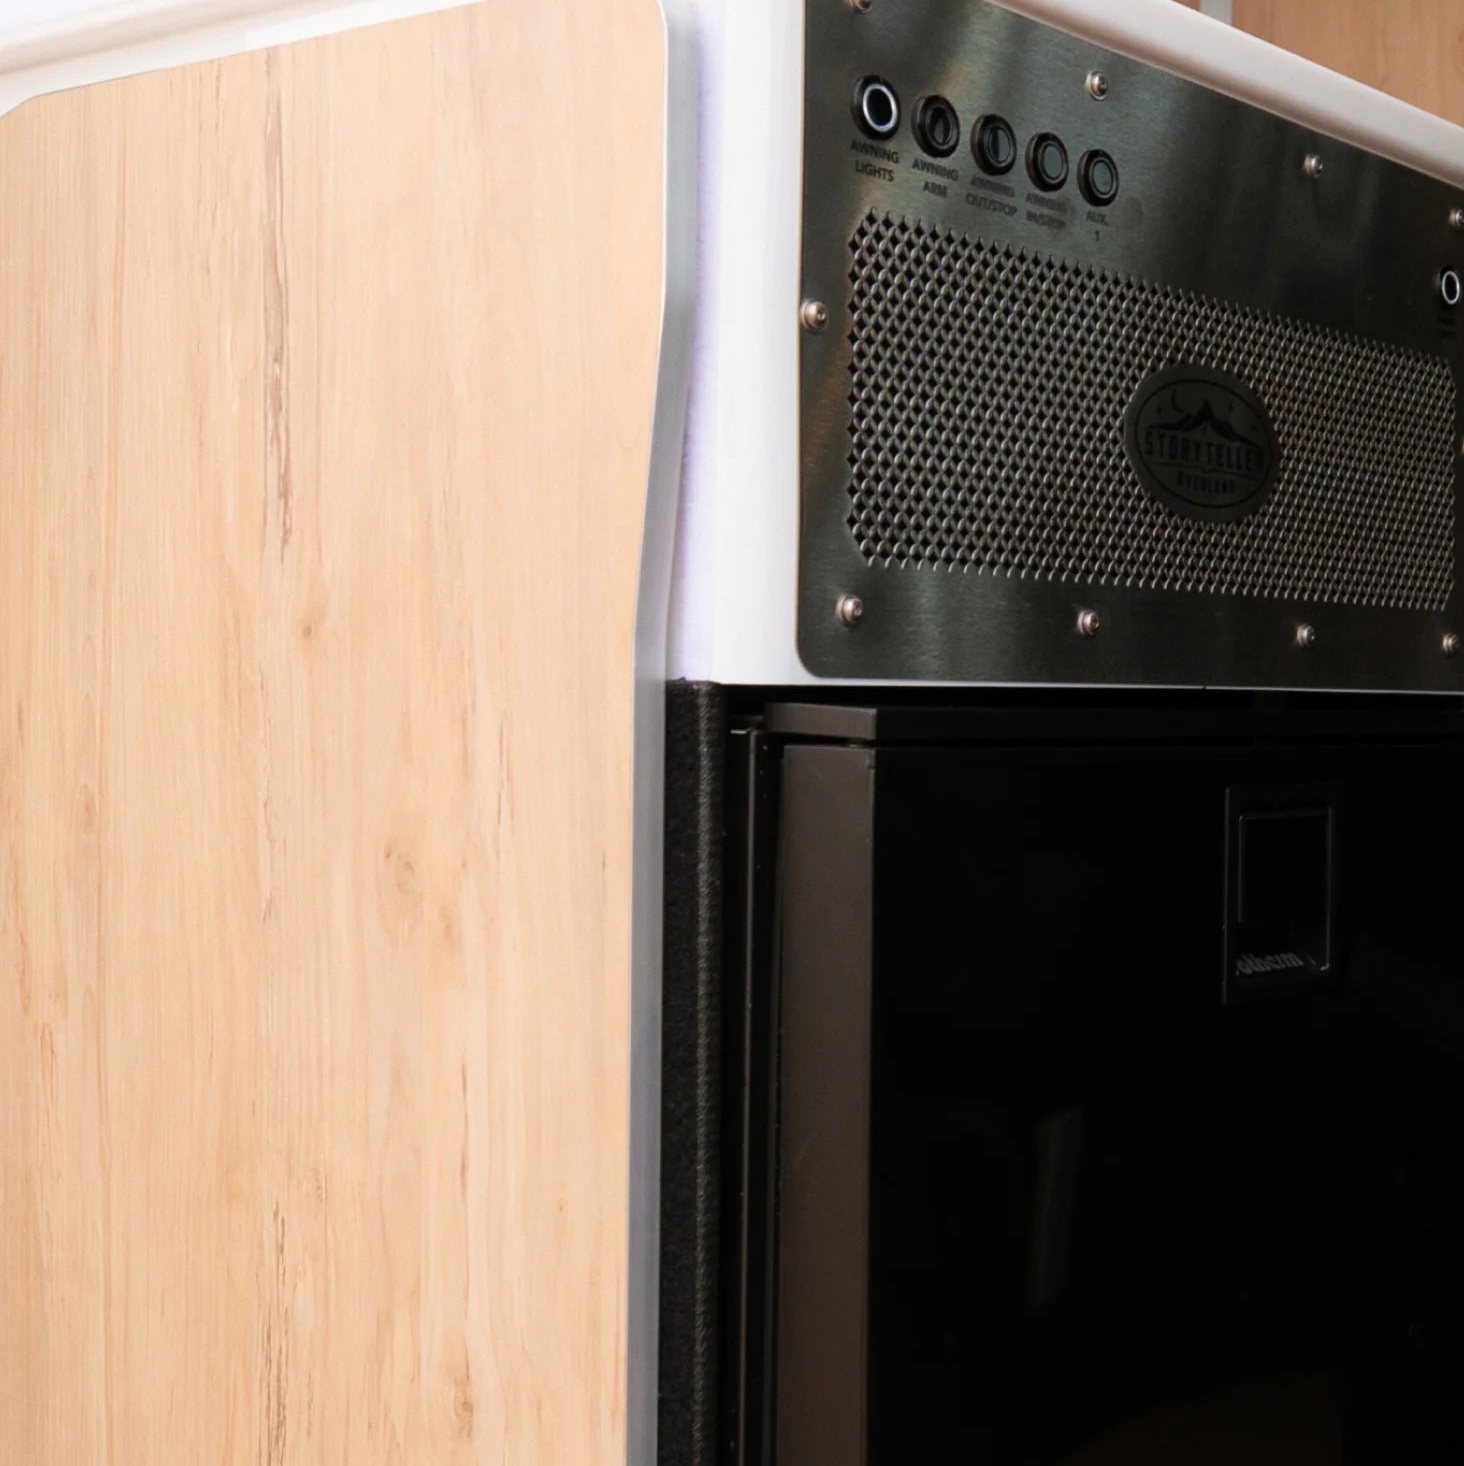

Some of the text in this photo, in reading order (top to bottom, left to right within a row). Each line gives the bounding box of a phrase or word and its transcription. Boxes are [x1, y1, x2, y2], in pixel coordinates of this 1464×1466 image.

[850, 138, 899, 164] AWNING
[855, 160, 895, 182] LIGHTS
[911, 157, 959, 181] AWNING
[1145, 430, 1264, 473] STORYTELLER
